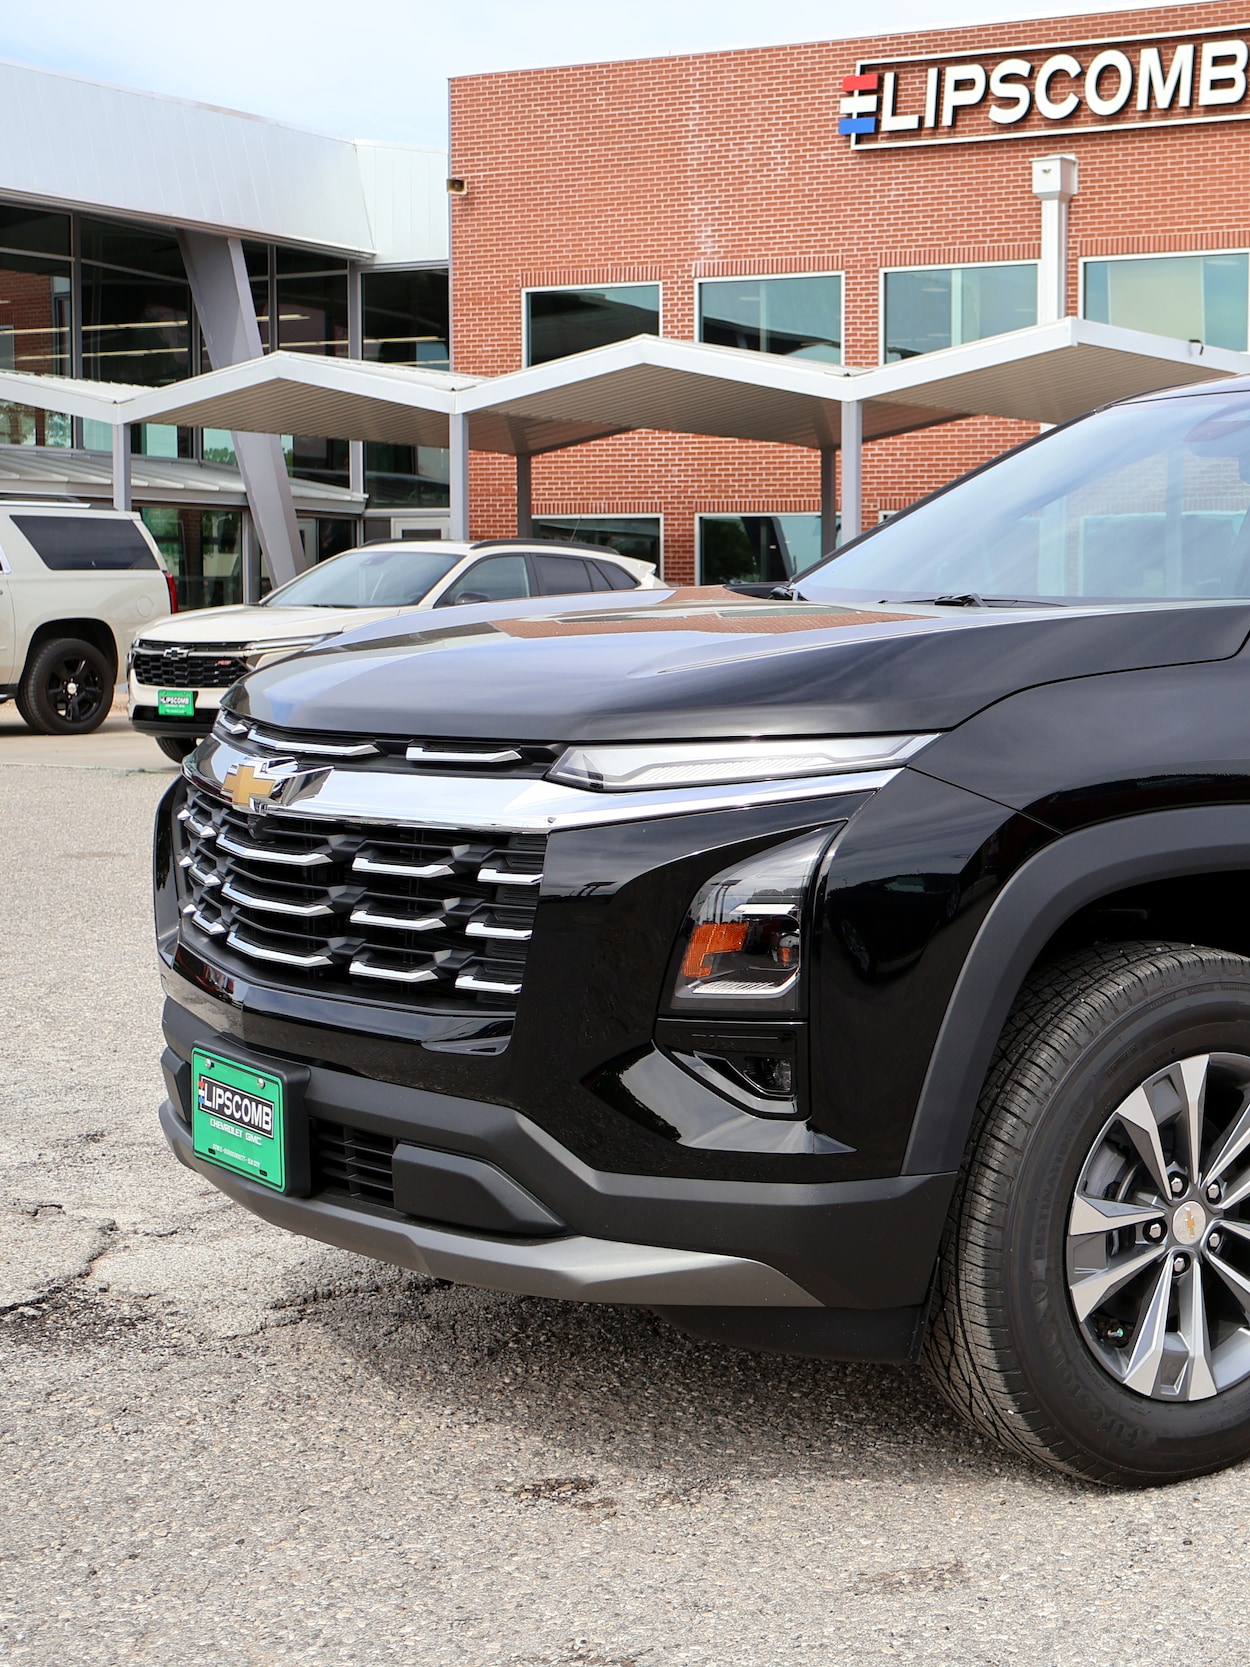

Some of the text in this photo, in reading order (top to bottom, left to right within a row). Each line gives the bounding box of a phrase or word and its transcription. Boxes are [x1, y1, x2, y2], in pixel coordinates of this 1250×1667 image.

[880, 38, 1250, 133] LIPSCOMB
[204, 1082, 273, 1132] LIPSCOMB
[209, 1117, 263, 1146] CHEVROLET GMC
